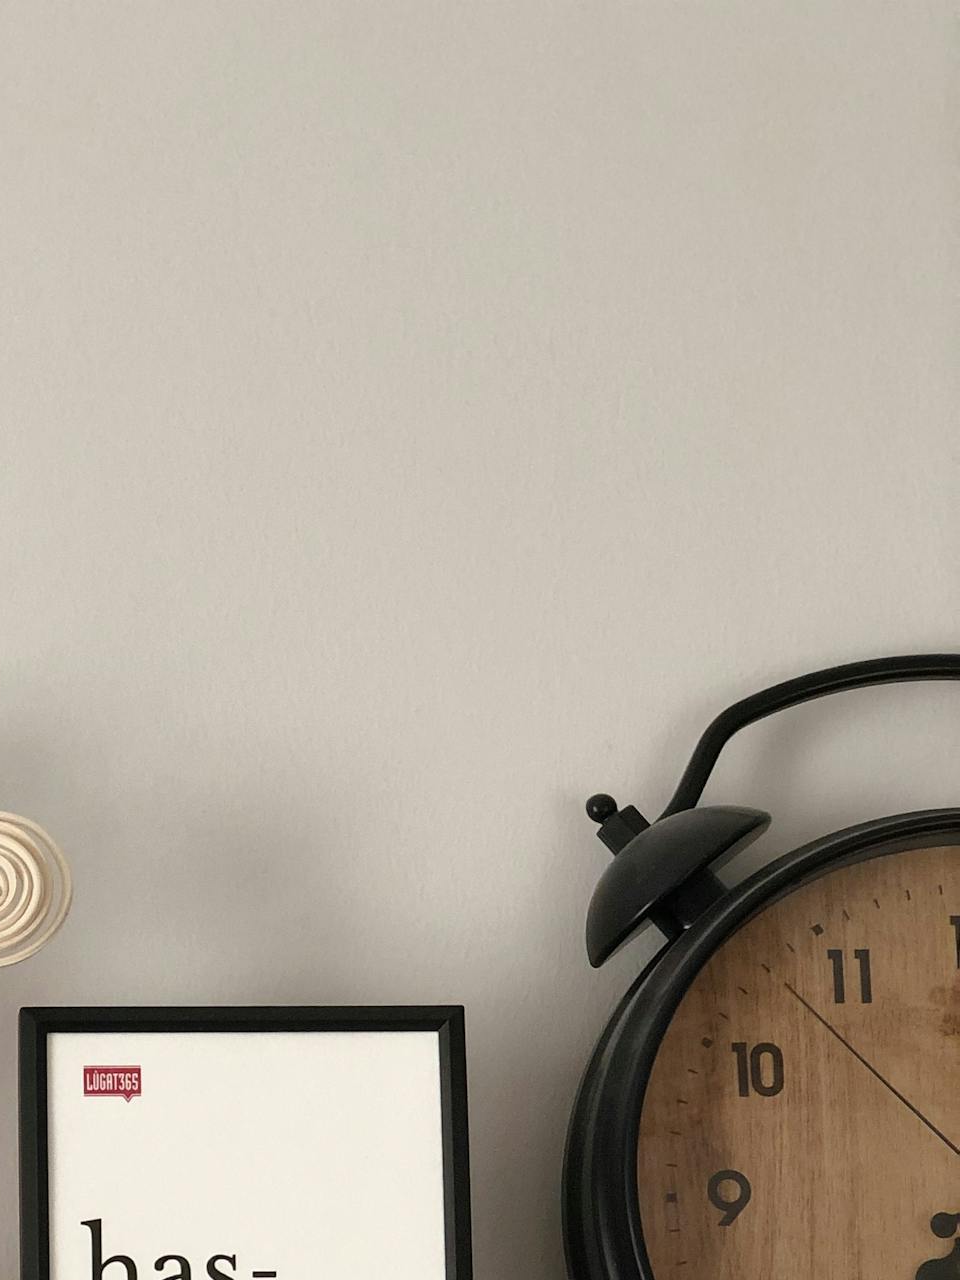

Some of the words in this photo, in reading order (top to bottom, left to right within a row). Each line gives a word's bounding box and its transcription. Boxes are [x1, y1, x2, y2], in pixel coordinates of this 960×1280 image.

[827, 949, 872, 1004] 11
[731, 1042, 785, 1097] 10
[707, 1170, 751, 1227] 9
